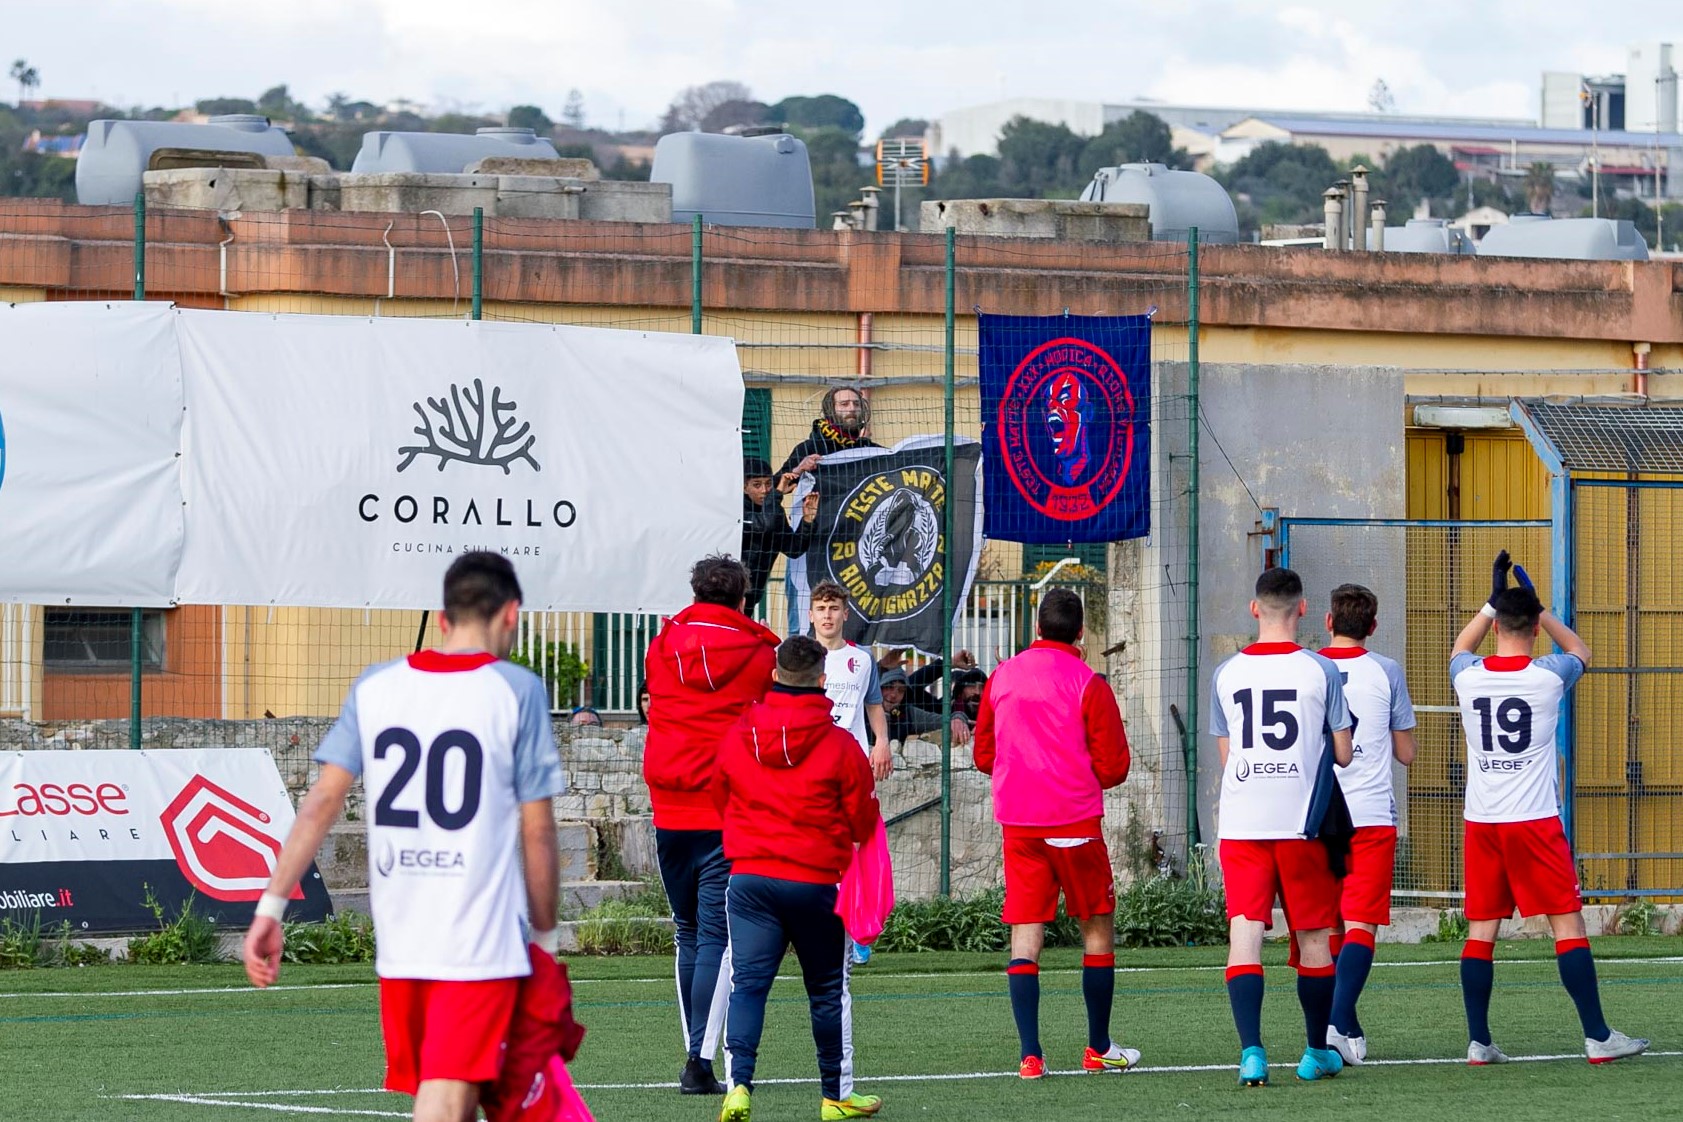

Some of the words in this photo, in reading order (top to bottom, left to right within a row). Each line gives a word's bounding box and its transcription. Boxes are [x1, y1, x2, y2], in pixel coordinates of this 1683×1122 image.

[1044, 348, 1093, 368] MODICA
[844, 475, 894, 523] TESTE
[901, 469, 946, 513] MATE
[358, 493, 577, 528] CORALLO
[392, 542, 453, 554] CUCINA
[500, 545, 541, 556] MARE
[831, 541, 856, 561] 20
[1233, 687, 1299, 751] 15
[1472, 697, 1533, 754] 19
[373, 727, 483, 831] 20
[1253, 762, 1300, 774] EGEA
[400, 850, 465, 869] EGEA
